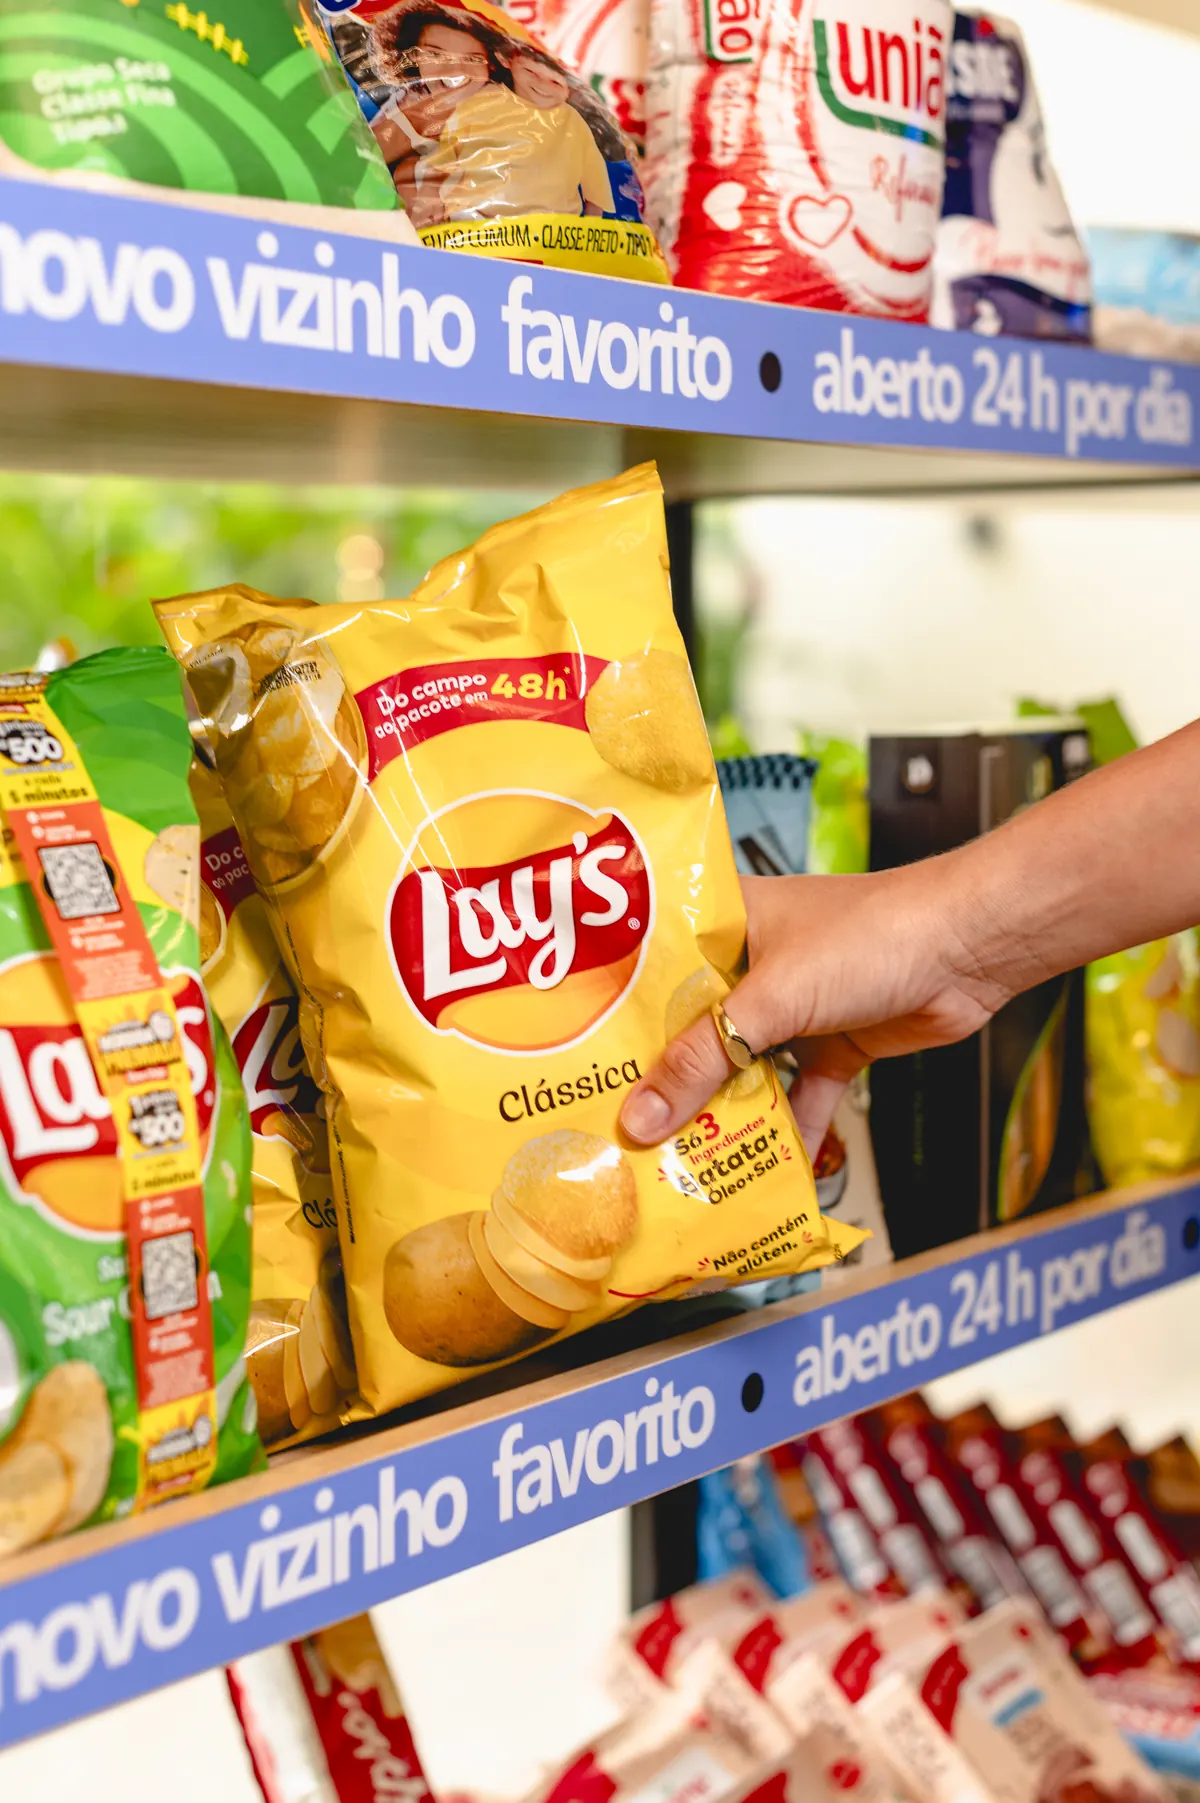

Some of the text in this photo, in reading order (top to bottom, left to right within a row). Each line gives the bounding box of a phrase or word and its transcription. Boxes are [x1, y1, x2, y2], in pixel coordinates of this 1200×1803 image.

[468, 224, 531, 248] COMUM
[541, 224, 585, 251] CLASSE:
[586, 227, 619, 254] PRETO
[625, 231, 647, 256] TIPO
[0, 222, 195, 333] novo
[207, 232, 476, 368] vizinho
[501, 275, 732, 401] favorito
[812, 327, 965, 424] aberto
[1064, 378, 1133, 456] por
[1134, 367, 1192, 447] dia
[374, 691, 488, 739] ao pacote em
[376, 693, 409, 717] Do
[411, 674, 487, 700] campo
[205, 851, 231, 872] Do
[420, 831, 629, 1001] Lay's
[498, 1056, 643, 1124] Clássica
[675, 1112, 721, 1157] Só 3
[689, 1116, 766, 1166] Ingredientes
[712, 1212, 809, 1271] Não contém
[0, 1567, 201, 1704] novo
[212, 1466, 469, 1623] vizinho
[492, 1382, 716, 1523] favorito
[793, 1299, 941, 1406] aberto
[1040, 1243, 1109, 1333] por
[1109, 1211, 1166, 1288] dia
